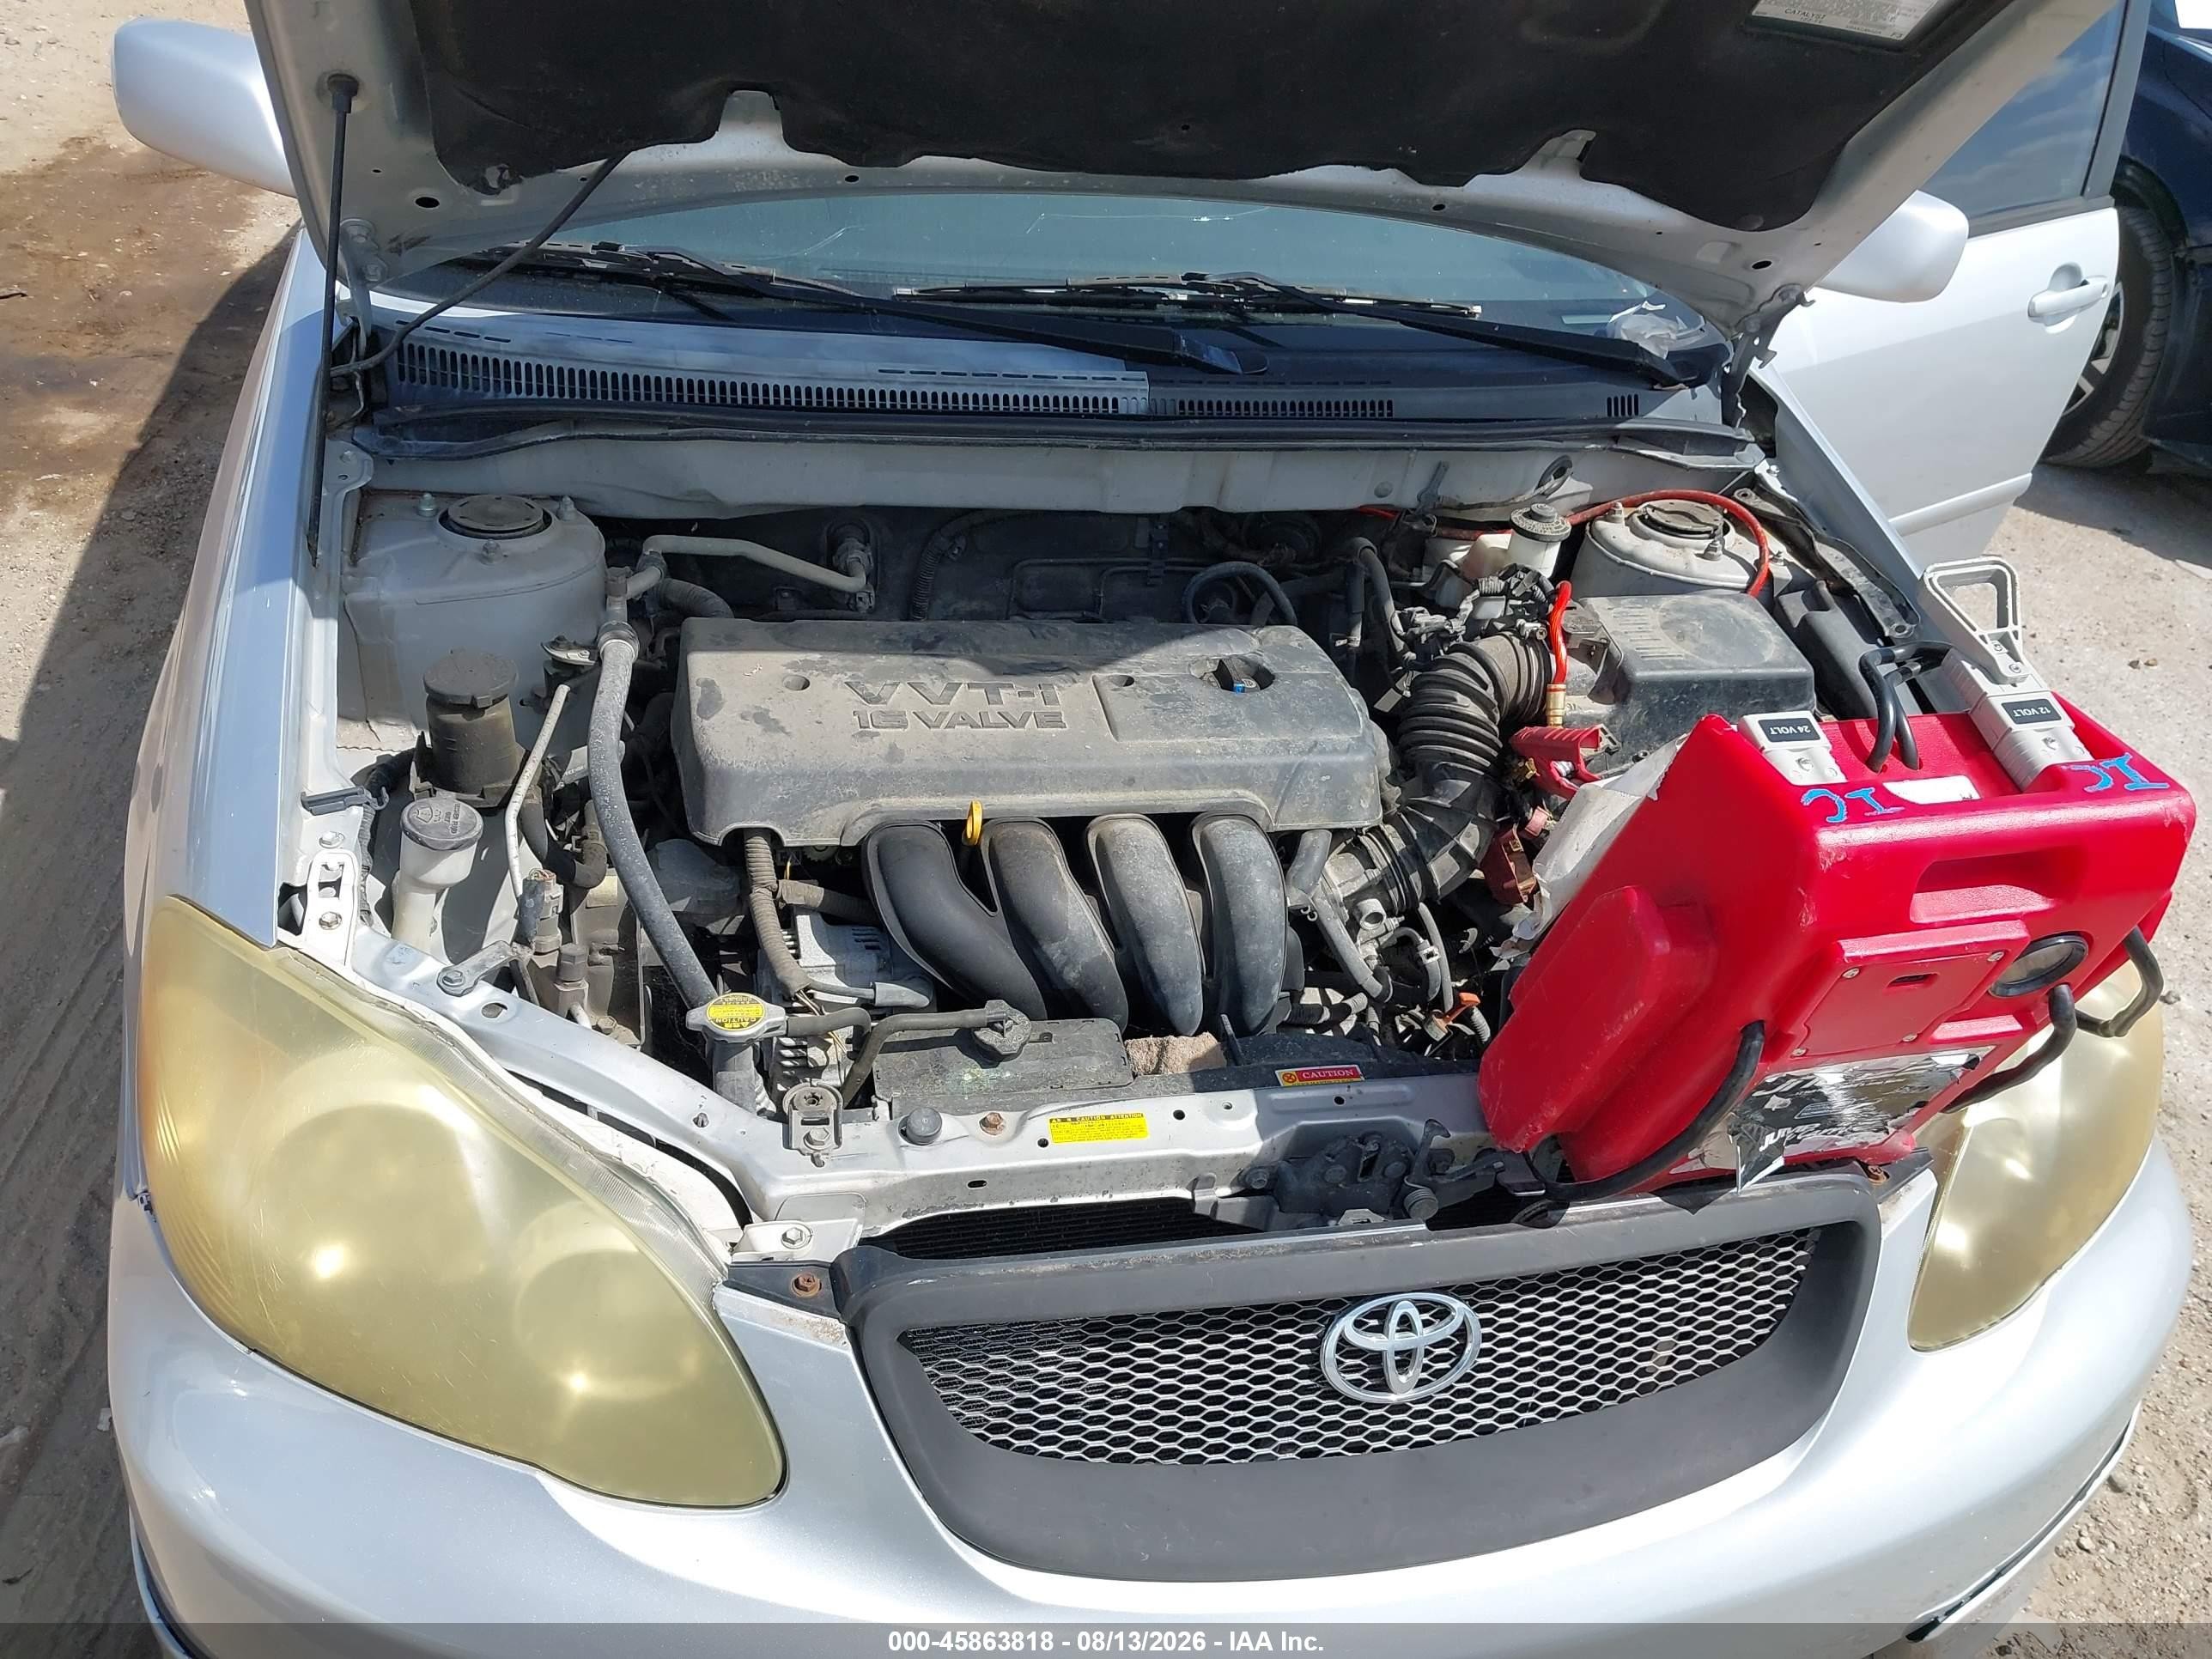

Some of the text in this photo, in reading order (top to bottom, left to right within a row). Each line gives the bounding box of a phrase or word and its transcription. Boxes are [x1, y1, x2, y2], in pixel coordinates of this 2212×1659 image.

[1784, 8, 1826, 19] CATALYST
[2013, 708, 2039, 716] VOLT
[853, 710, 1067, 730] 16 VALVE
[1302, 1069, 1354, 1079] CAUTION
